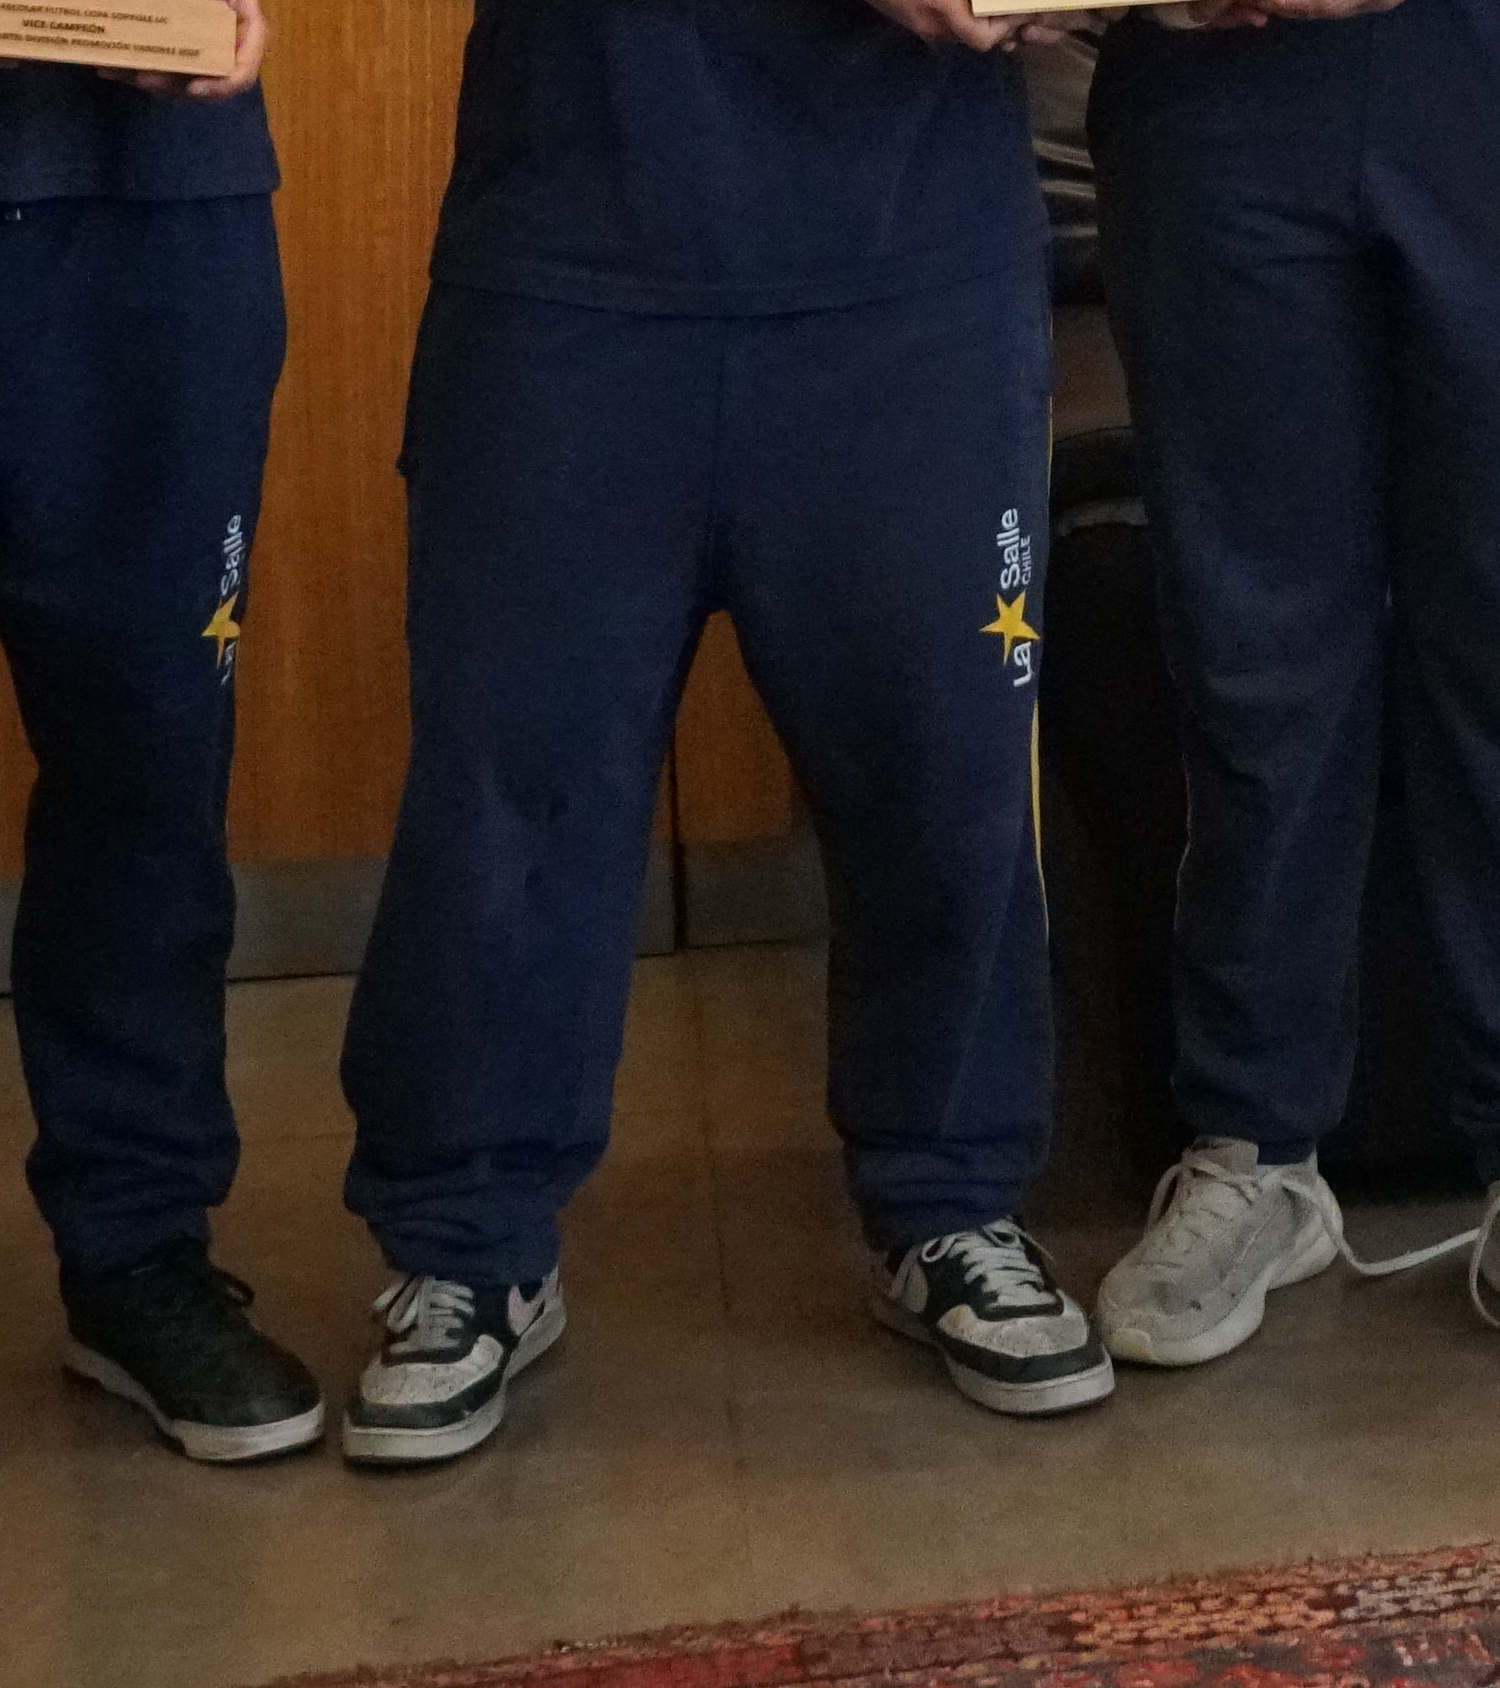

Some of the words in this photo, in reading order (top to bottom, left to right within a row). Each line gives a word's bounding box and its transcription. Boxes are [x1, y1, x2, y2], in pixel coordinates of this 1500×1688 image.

[996, 508, 1021, 590] Salle
[1020, 535, 1033, 586] CHILE
[1013, 641, 1035, 688] La
